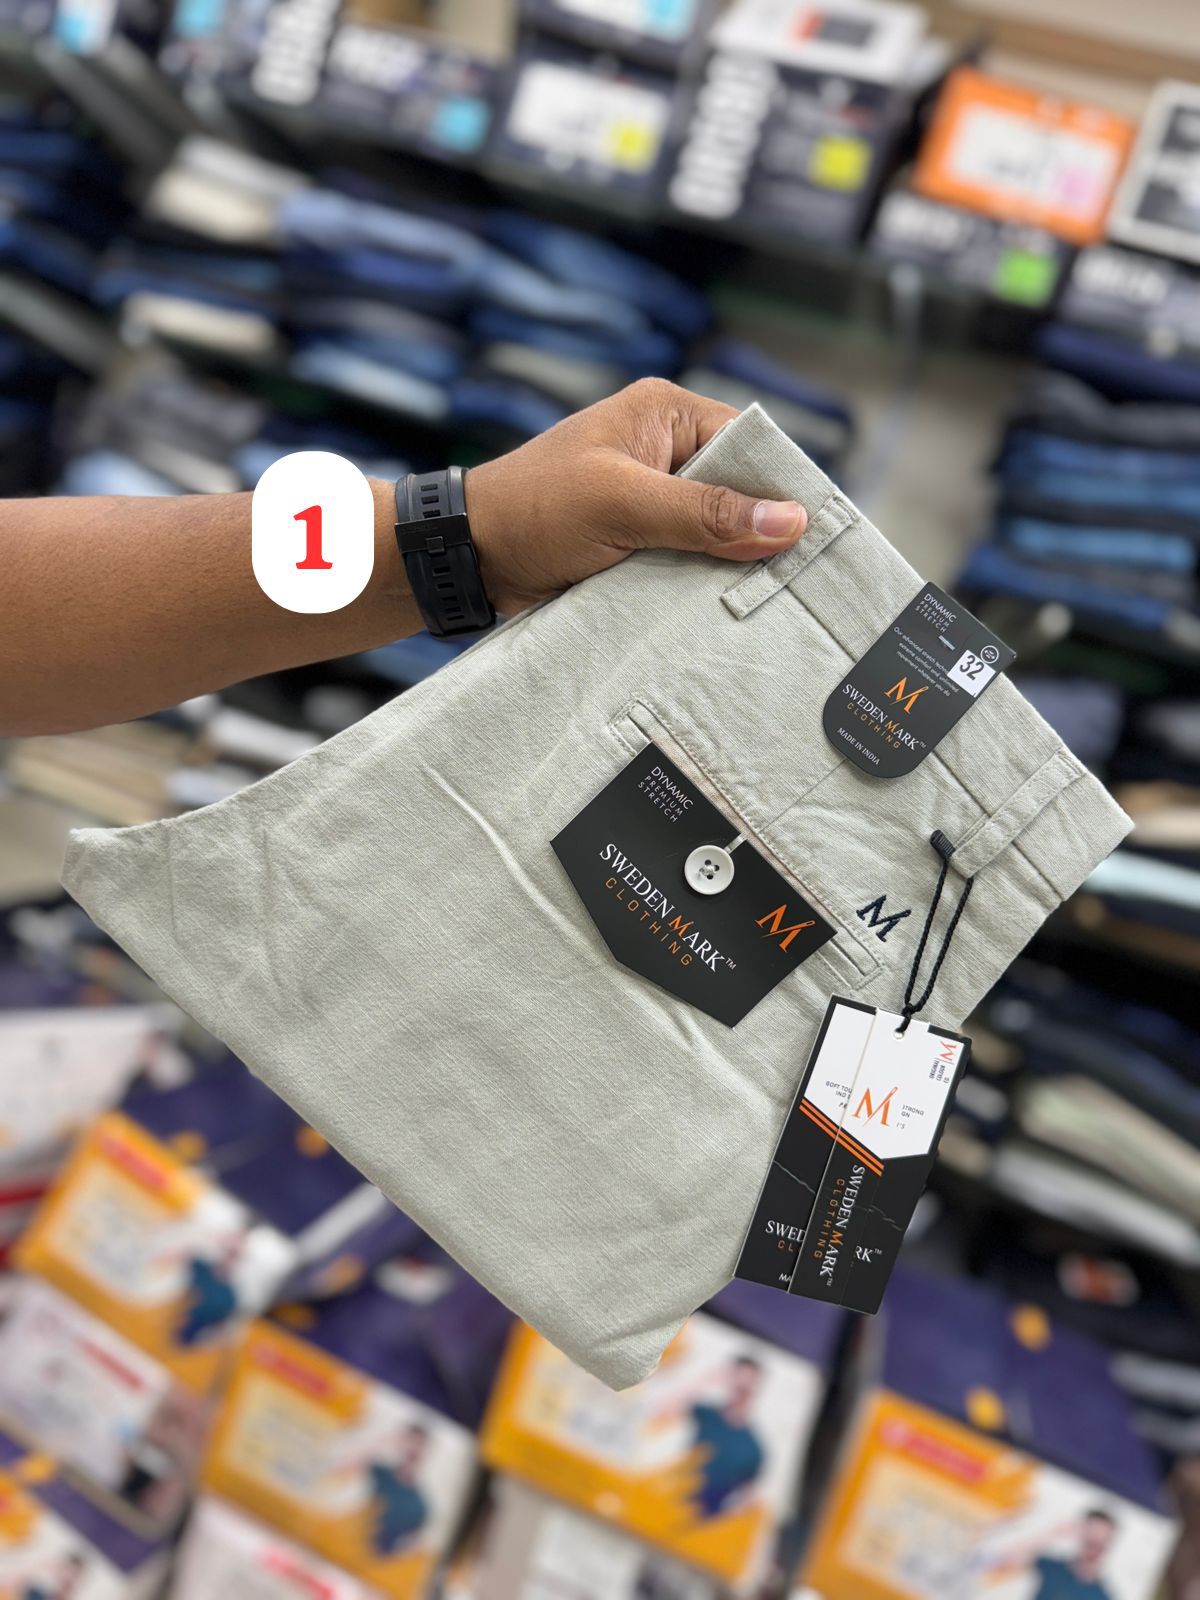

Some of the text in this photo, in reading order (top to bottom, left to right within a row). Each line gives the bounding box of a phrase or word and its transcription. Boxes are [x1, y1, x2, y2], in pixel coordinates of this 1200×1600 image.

[915, 605, 946, 632] STRETCH
[919, 600, 950, 627] PREMIUM
[924, 593, 957, 622] DYNAMIC
[894, 626, 902, 635] Our
[902, 635, 923, 652] advanced
[922, 651, 935, 663] stretch
[897, 650, 918, 669] movement
[918, 668, 936, 684] whatever
[935, 683, 944, 692] you
[899, 643, 959, 692] extreme comfort and unlimited
[960, 655, 985, 681] 32
[842, 684, 888, 723] SWEDEN
[847, 702, 901, 749] CLOTHING
[837, 727, 881, 765] MADE IN INDIA
[637, 781, 678, 823] STRETCH
[644, 775, 683, 816] PREMIUM
[651, 766, 694, 810] DYNAMIC
[599, 843, 675, 919] SWEDEN
[605, 877, 693, 966] CLOTHING
[825, 1080, 840, 1089] SOFT
[841, 1085, 852, 1094] TOU
[835, 1164, 866, 1229] SWEDEN
[765, 1220, 806, 1242] SWED
[814, 1178, 846, 1259] CLOTHING
[777, 1239, 795, 1252] CL
